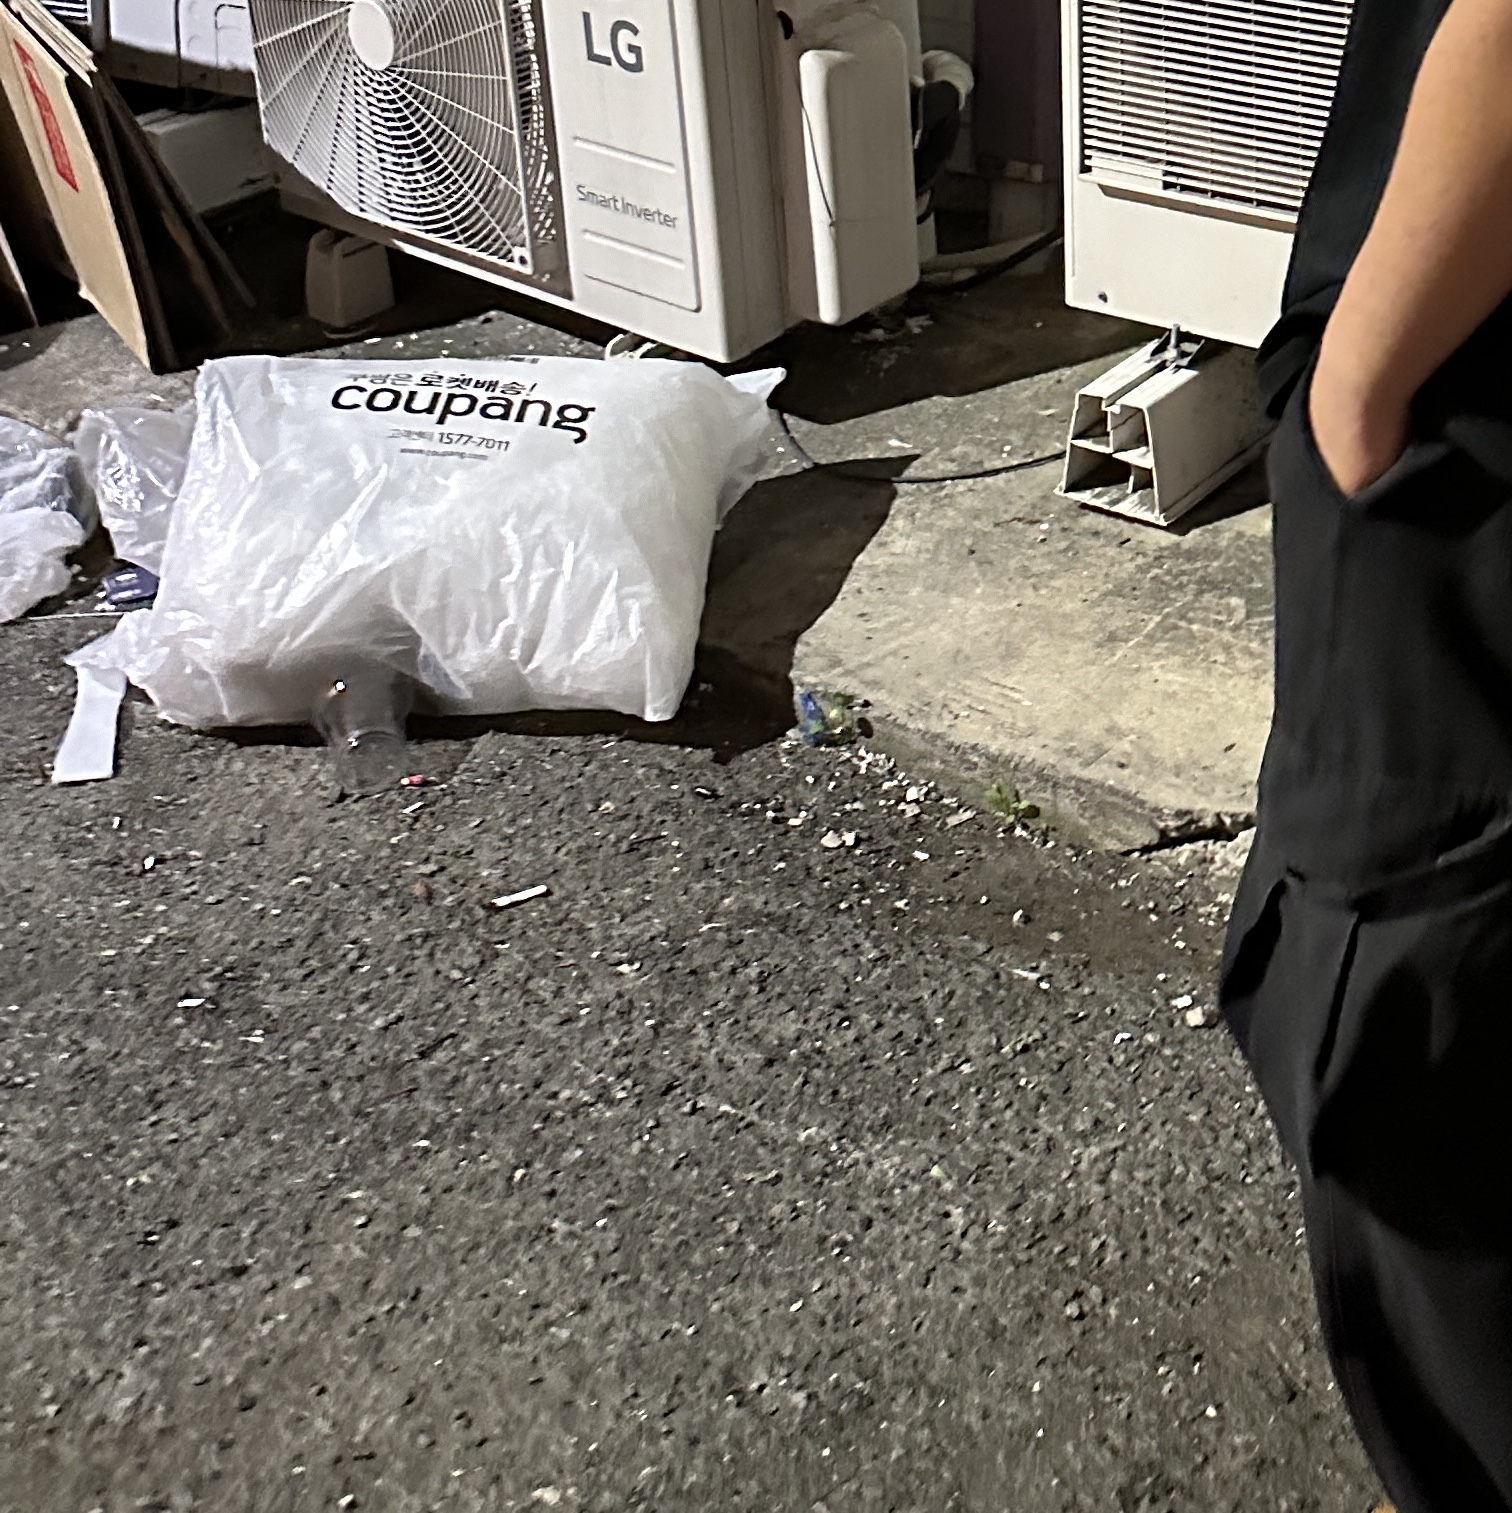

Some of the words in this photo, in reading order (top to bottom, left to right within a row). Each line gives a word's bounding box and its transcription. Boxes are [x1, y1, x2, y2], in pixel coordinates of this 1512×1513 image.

[582, 11, 644, 73] LG
[576, 184, 620, 212] Smart
[620, 195, 679, 229] Inverter
[331, 385, 596, 445] coupang
[438, 431, 511, 452] 1577-7011
